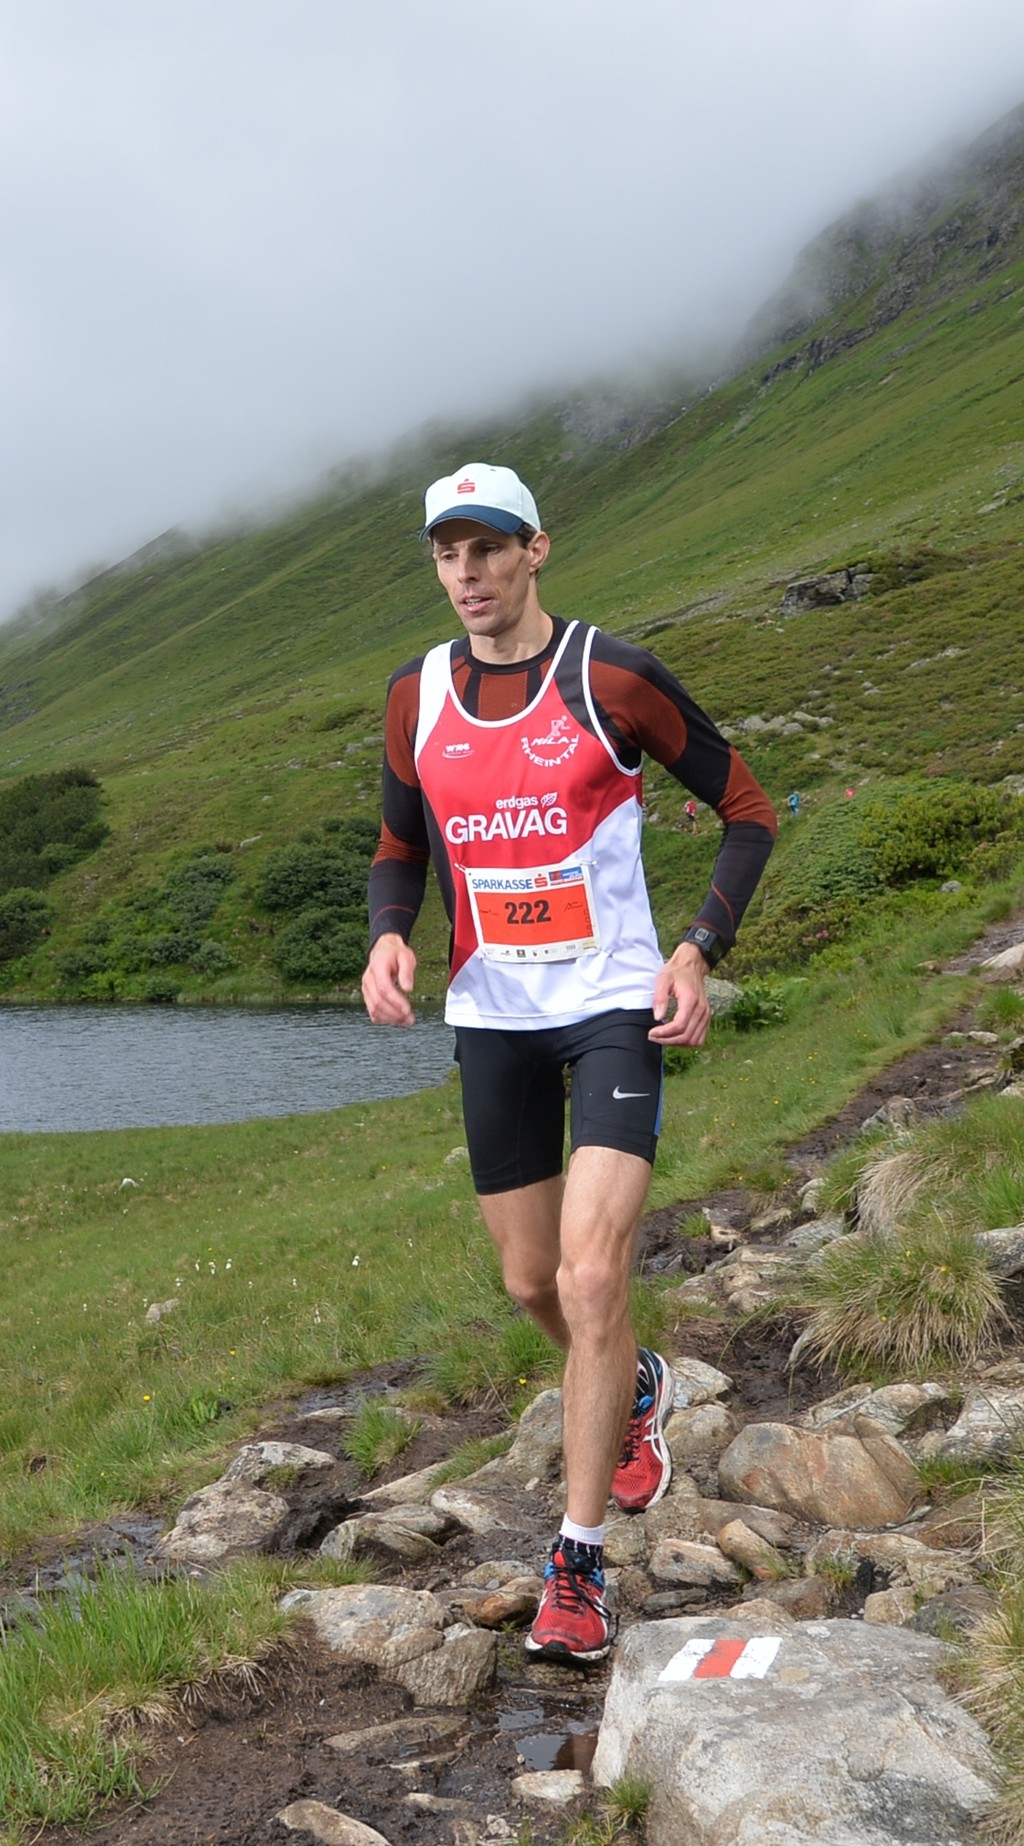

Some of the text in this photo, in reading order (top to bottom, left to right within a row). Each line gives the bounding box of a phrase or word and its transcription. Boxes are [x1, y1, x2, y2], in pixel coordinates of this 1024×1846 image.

[521, 733, 580, 768] RHEINTAL
[496, 795, 538, 809] erdgas
[445, 807, 567, 844] GRAVAG
[472, 879, 534, 889] SPARKASSE
[504, 899, 552, 925] 222
